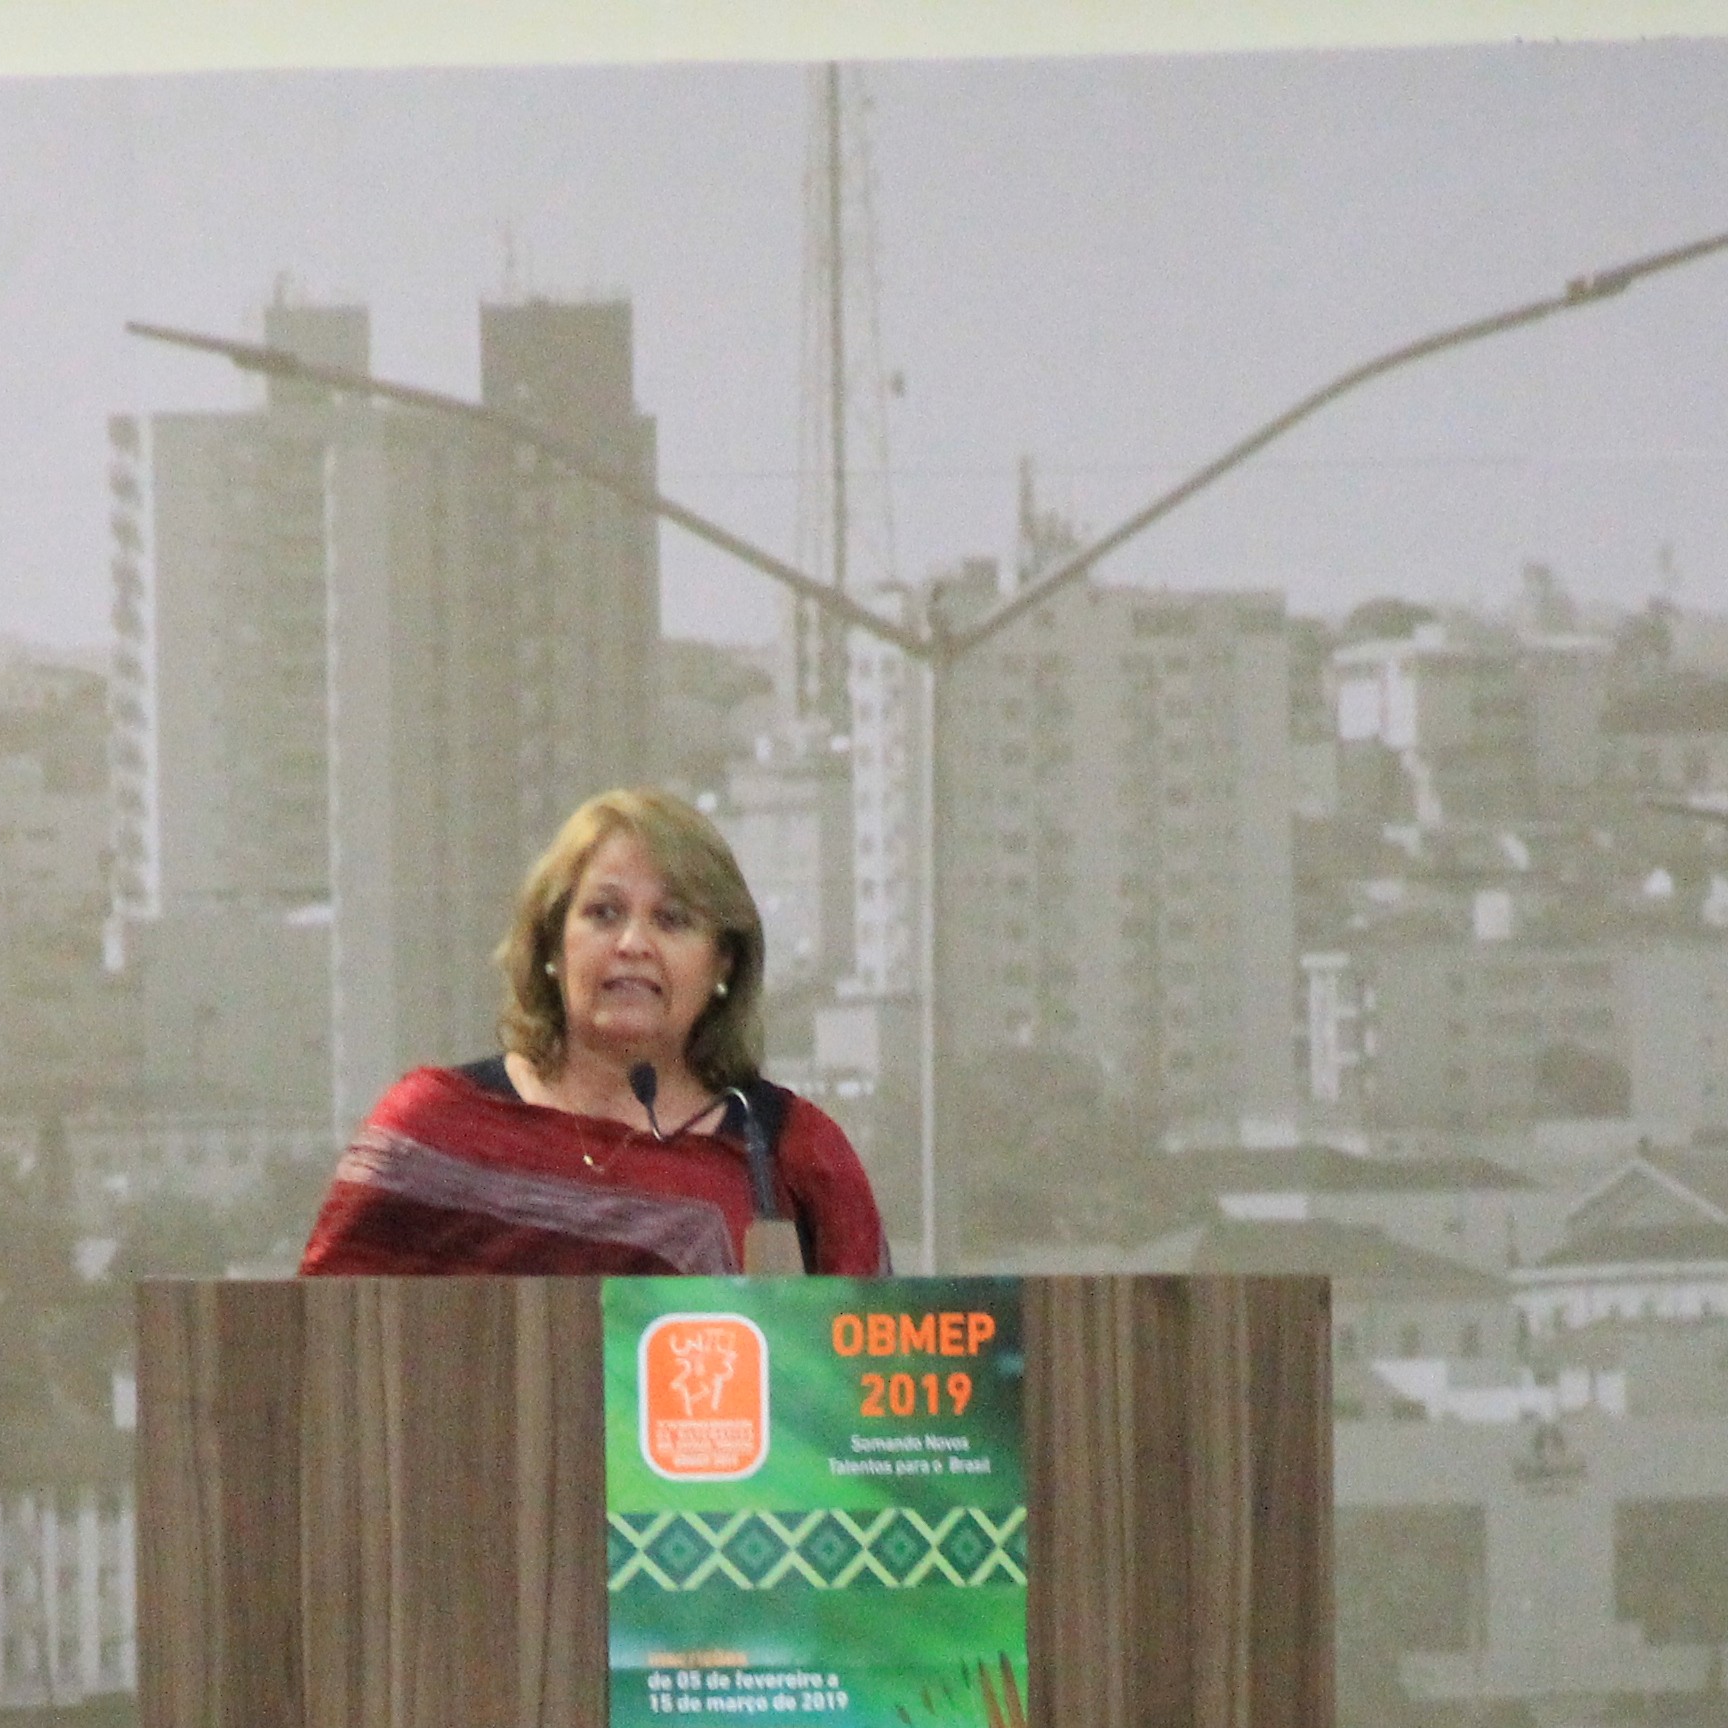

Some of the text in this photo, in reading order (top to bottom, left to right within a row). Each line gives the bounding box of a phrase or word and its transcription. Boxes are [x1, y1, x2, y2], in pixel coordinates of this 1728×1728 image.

[832, 1312, 996, 1357] OBMEP
[859, 1372, 972, 1417] 2019
[895, 1459, 930, 1476] para
[647, 1670, 672, 1690] de
[706, 1670, 731, 1690] de
[736, 1669, 823, 1690] fevereiro
[827, 1673, 839, 1688] a
[650, 1691, 848, 1715] 15 de março de 2019
